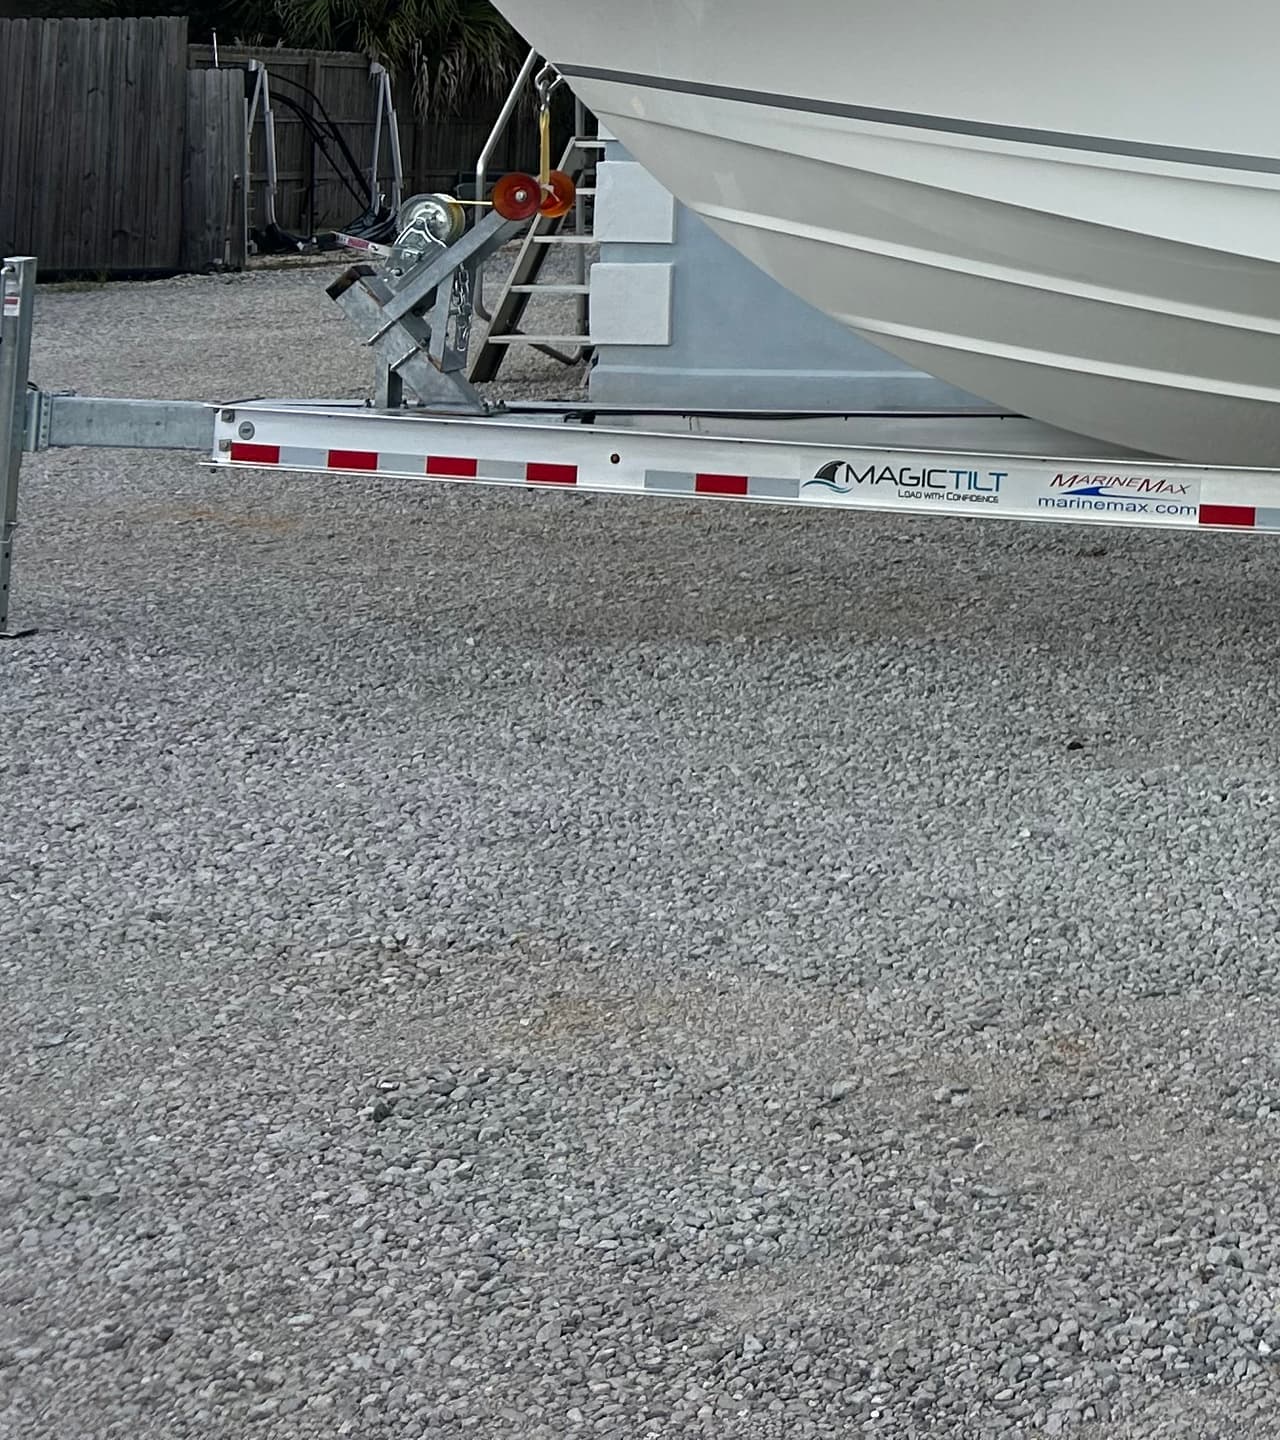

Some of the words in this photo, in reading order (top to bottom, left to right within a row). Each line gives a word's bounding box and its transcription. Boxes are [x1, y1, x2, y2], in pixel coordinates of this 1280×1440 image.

[844, 464, 1008, 493] MAGICTILT
[1050, 473, 1191, 495] MARINEMAX
[898, 489, 921, 499] LOAD
[924, 492, 944, 500] WITH
[946, 492, 999, 503] CONFIDENCE
[1038, 497, 1197, 516] marinemax.com
